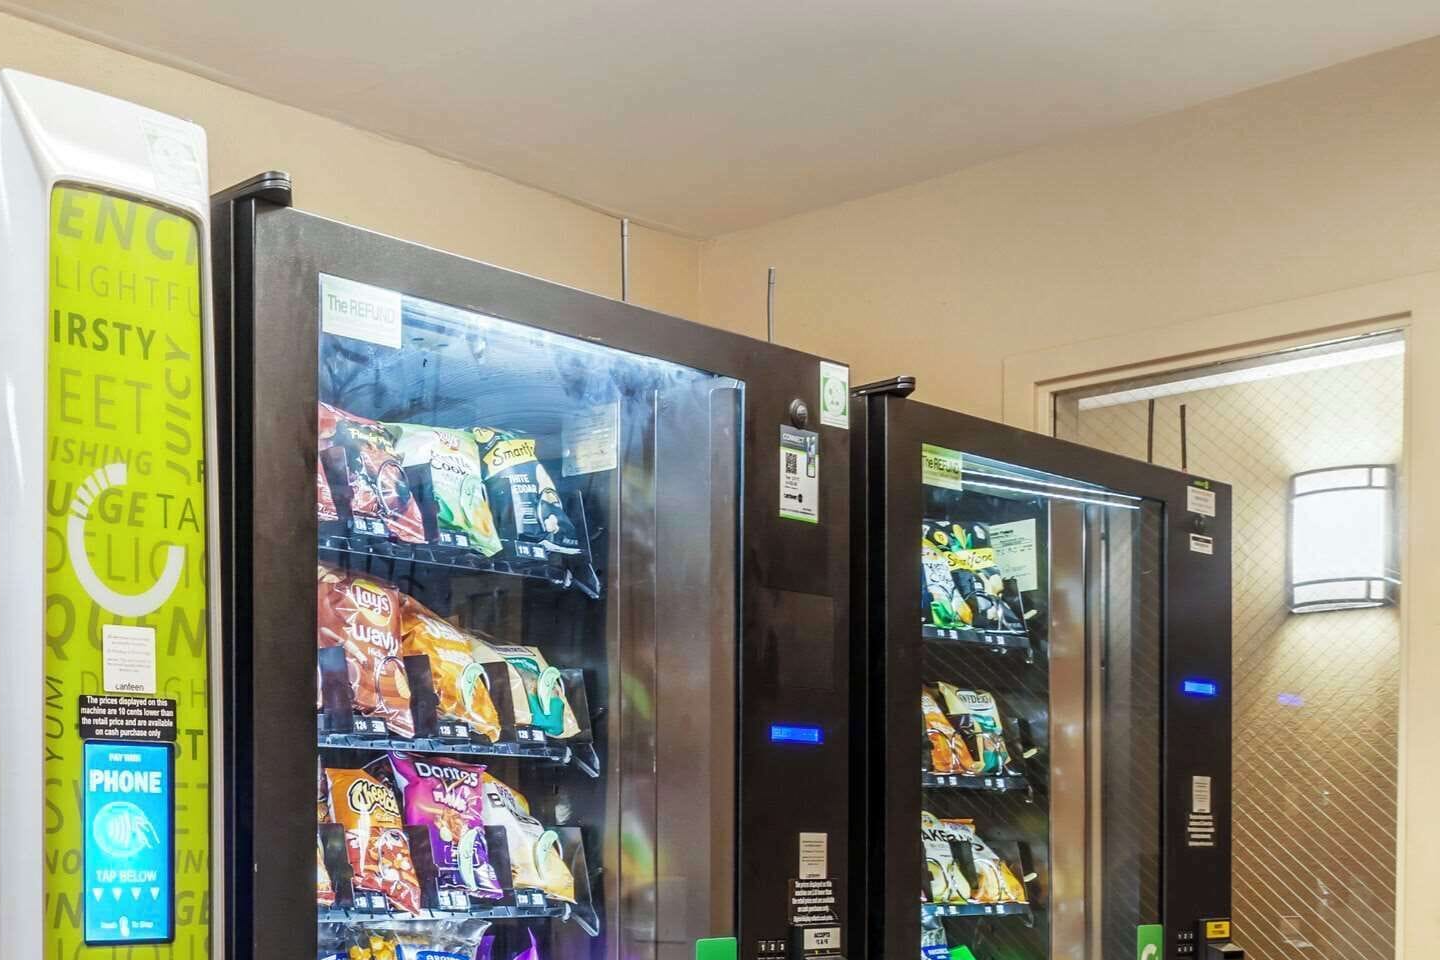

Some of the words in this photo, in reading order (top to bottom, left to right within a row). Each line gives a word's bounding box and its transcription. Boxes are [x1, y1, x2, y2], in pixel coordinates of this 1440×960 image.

[327, 293, 348, 314] The
[53, 309, 156, 361] IRSTY
[60, 366, 153, 435] EET
[164, 333, 192, 485] JUICY
[115, 682, 145, 692] canteen
[86, 696, 98, 704] The
[99, 697, 117, 706] prices
[119, 696, 147, 707] displayed
[157, 698, 168, 706] this
[80, 706, 106, 715] machine
[118, 707, 126, 715] 10
[127, 707, 143, 716] cents
[144, 708, 160, 716] lower
[161, 708, 174, 717] than
[81, 717, 92, 725] the
[93, 717, 108, 726] retail
[109, 718, 124, 727] price
[125, 718, 137, 726] and
[137, 719, 147, 727] are
[148, 718, 173, 727] available
[95, 728, 104, 736] on
[105, 728, 119, 736] cash
[120, 728, 147, 738] purchase
[148, 729, 161, 739] only
[89, 769, 162, 793] PHONE
[415, 761, 479, 788] Doritos
[96, 870, 116, 882] TAP
[119, 870, 157, 883] BELOW
